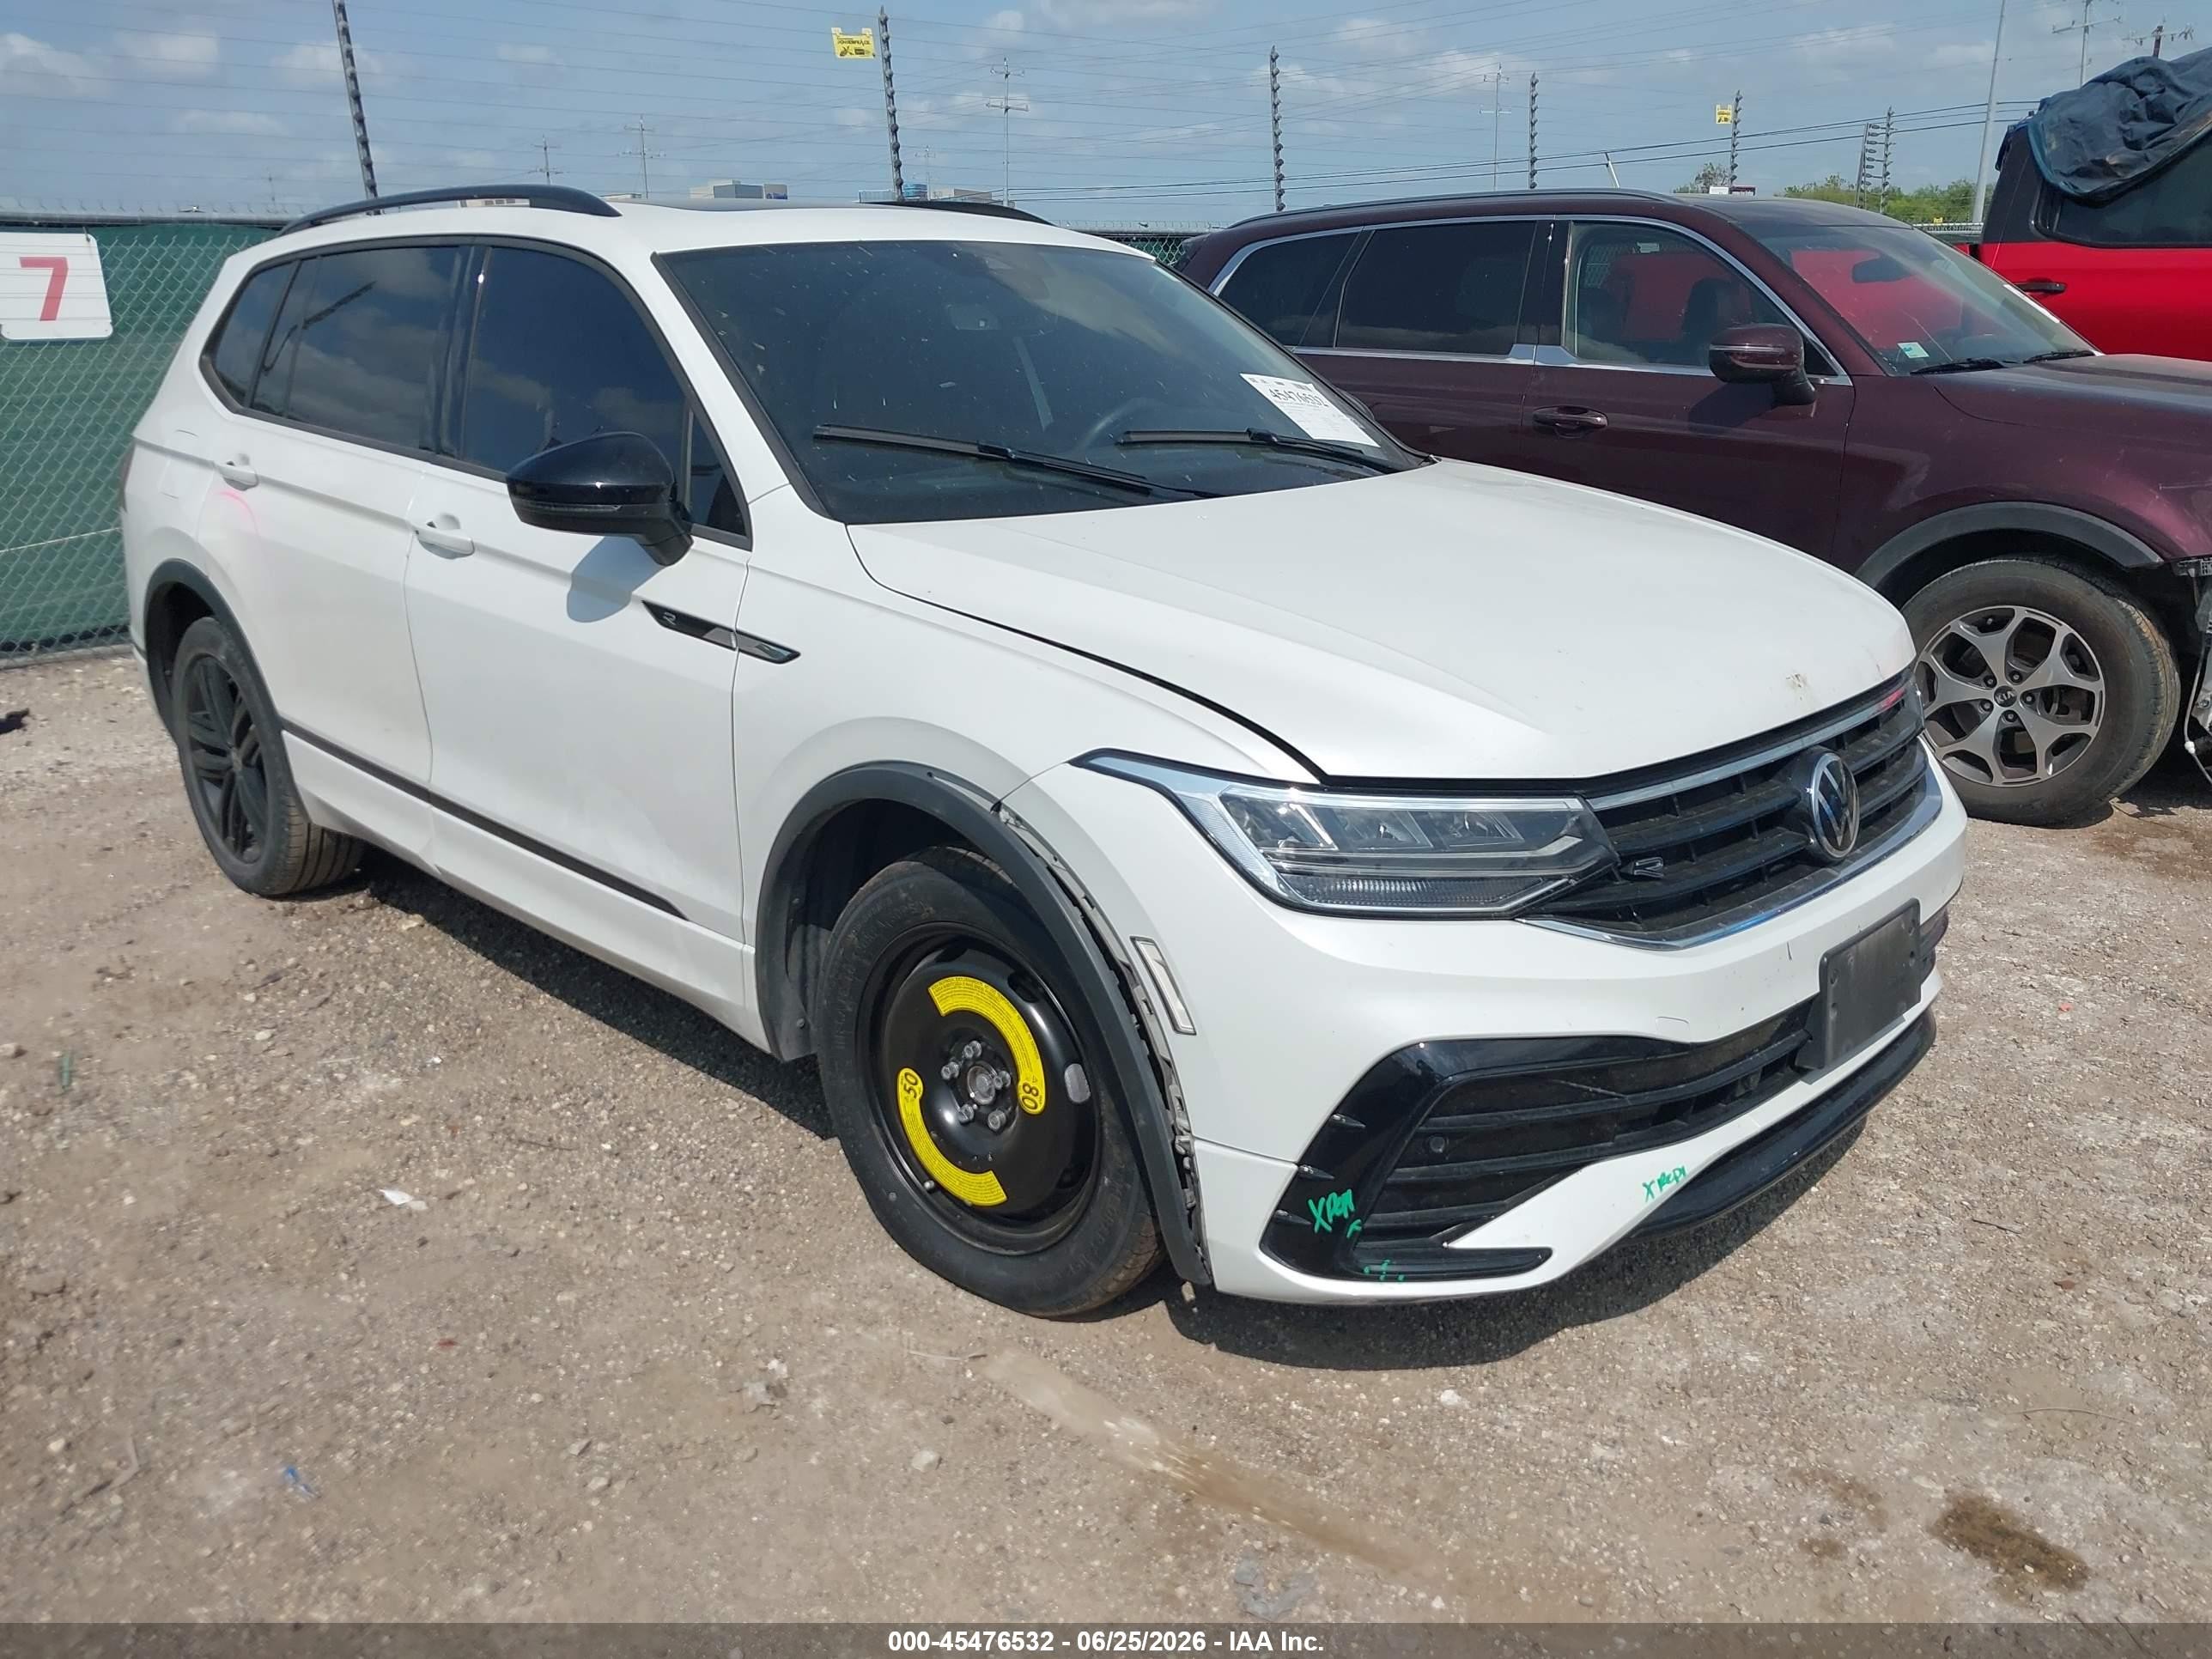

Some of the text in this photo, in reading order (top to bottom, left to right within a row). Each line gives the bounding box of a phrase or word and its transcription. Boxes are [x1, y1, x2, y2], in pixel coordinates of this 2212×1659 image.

[19, 256, 69, 321] 7
[1995, 690, 2014, 704] KIA
[902, 1072, 919, 1099] 50
[1020, 1081, 1040, 1110] 80
